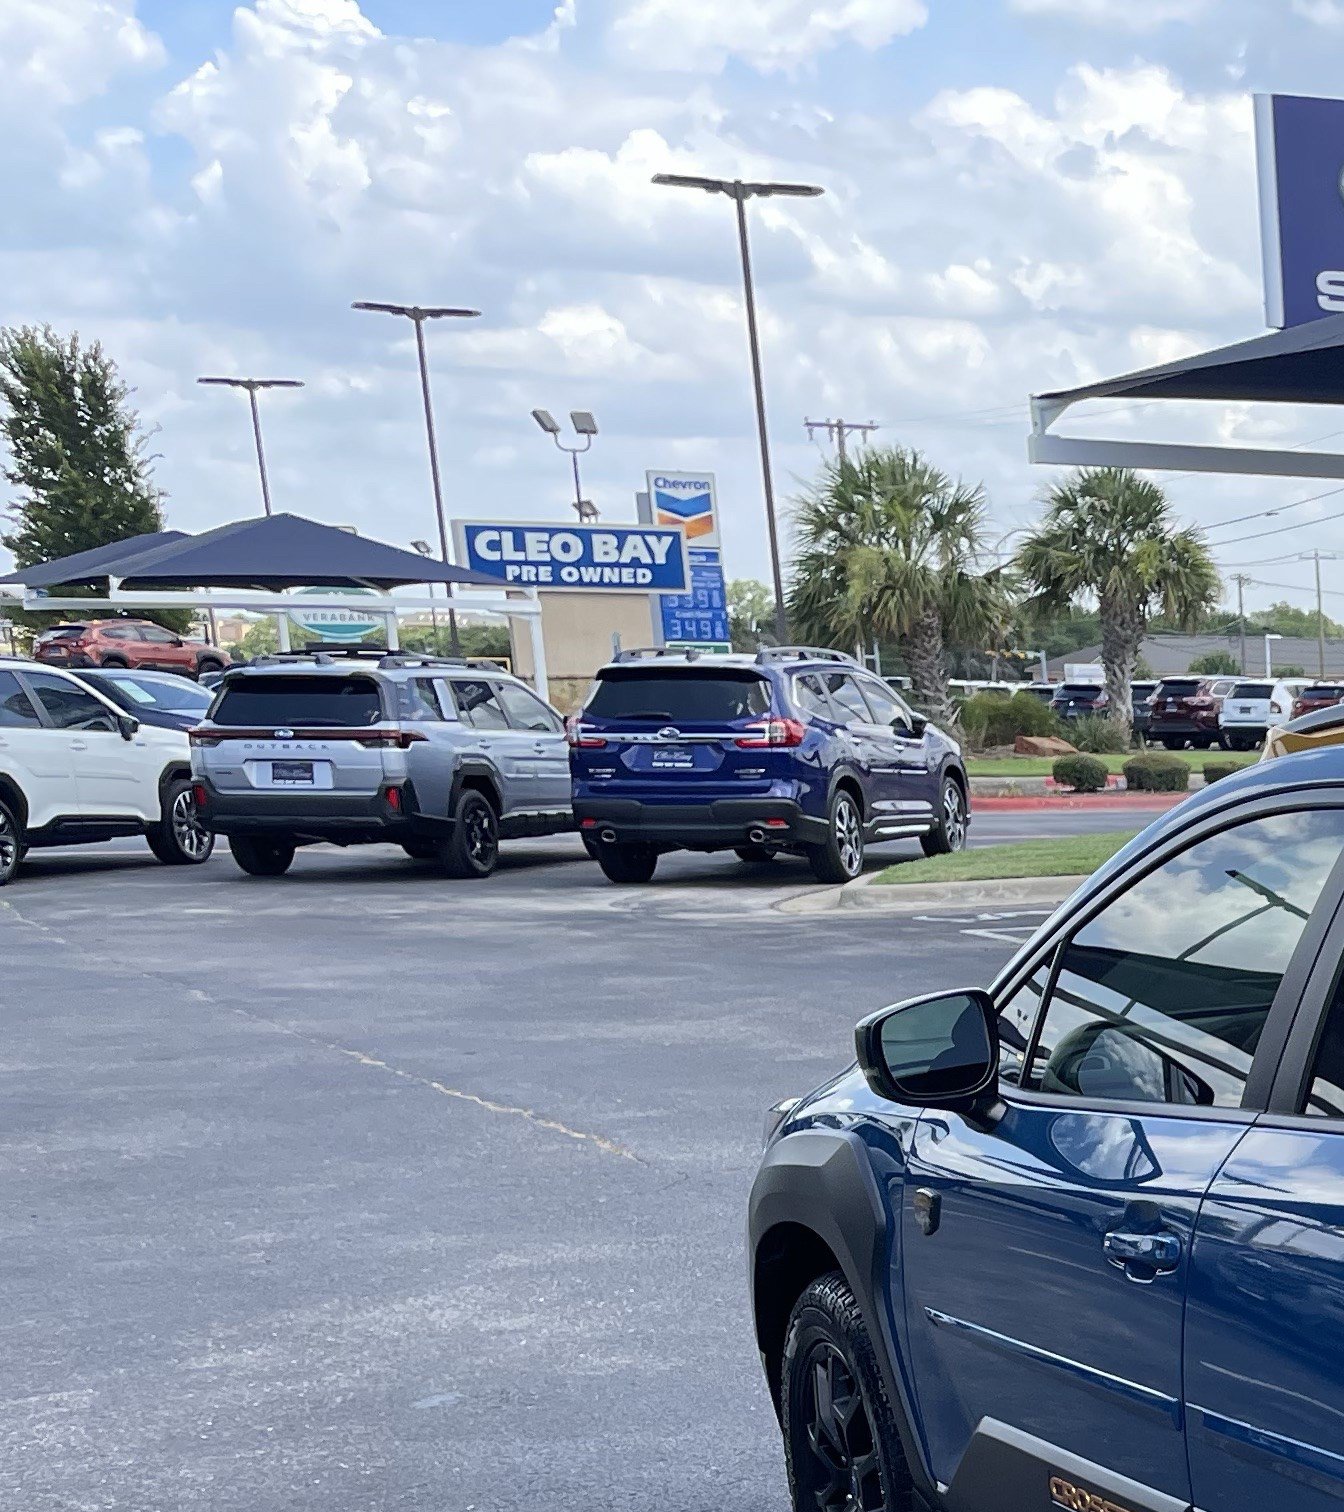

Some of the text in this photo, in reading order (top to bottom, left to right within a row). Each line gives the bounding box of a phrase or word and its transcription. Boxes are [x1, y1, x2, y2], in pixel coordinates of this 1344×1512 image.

[653, 476, 711, 491] Chevron
[474, 529, 674, 565] CLEO BAY
[505, 565, 653, 585] PRE OWNED
[302, 612, 375, 622] VERABANK
